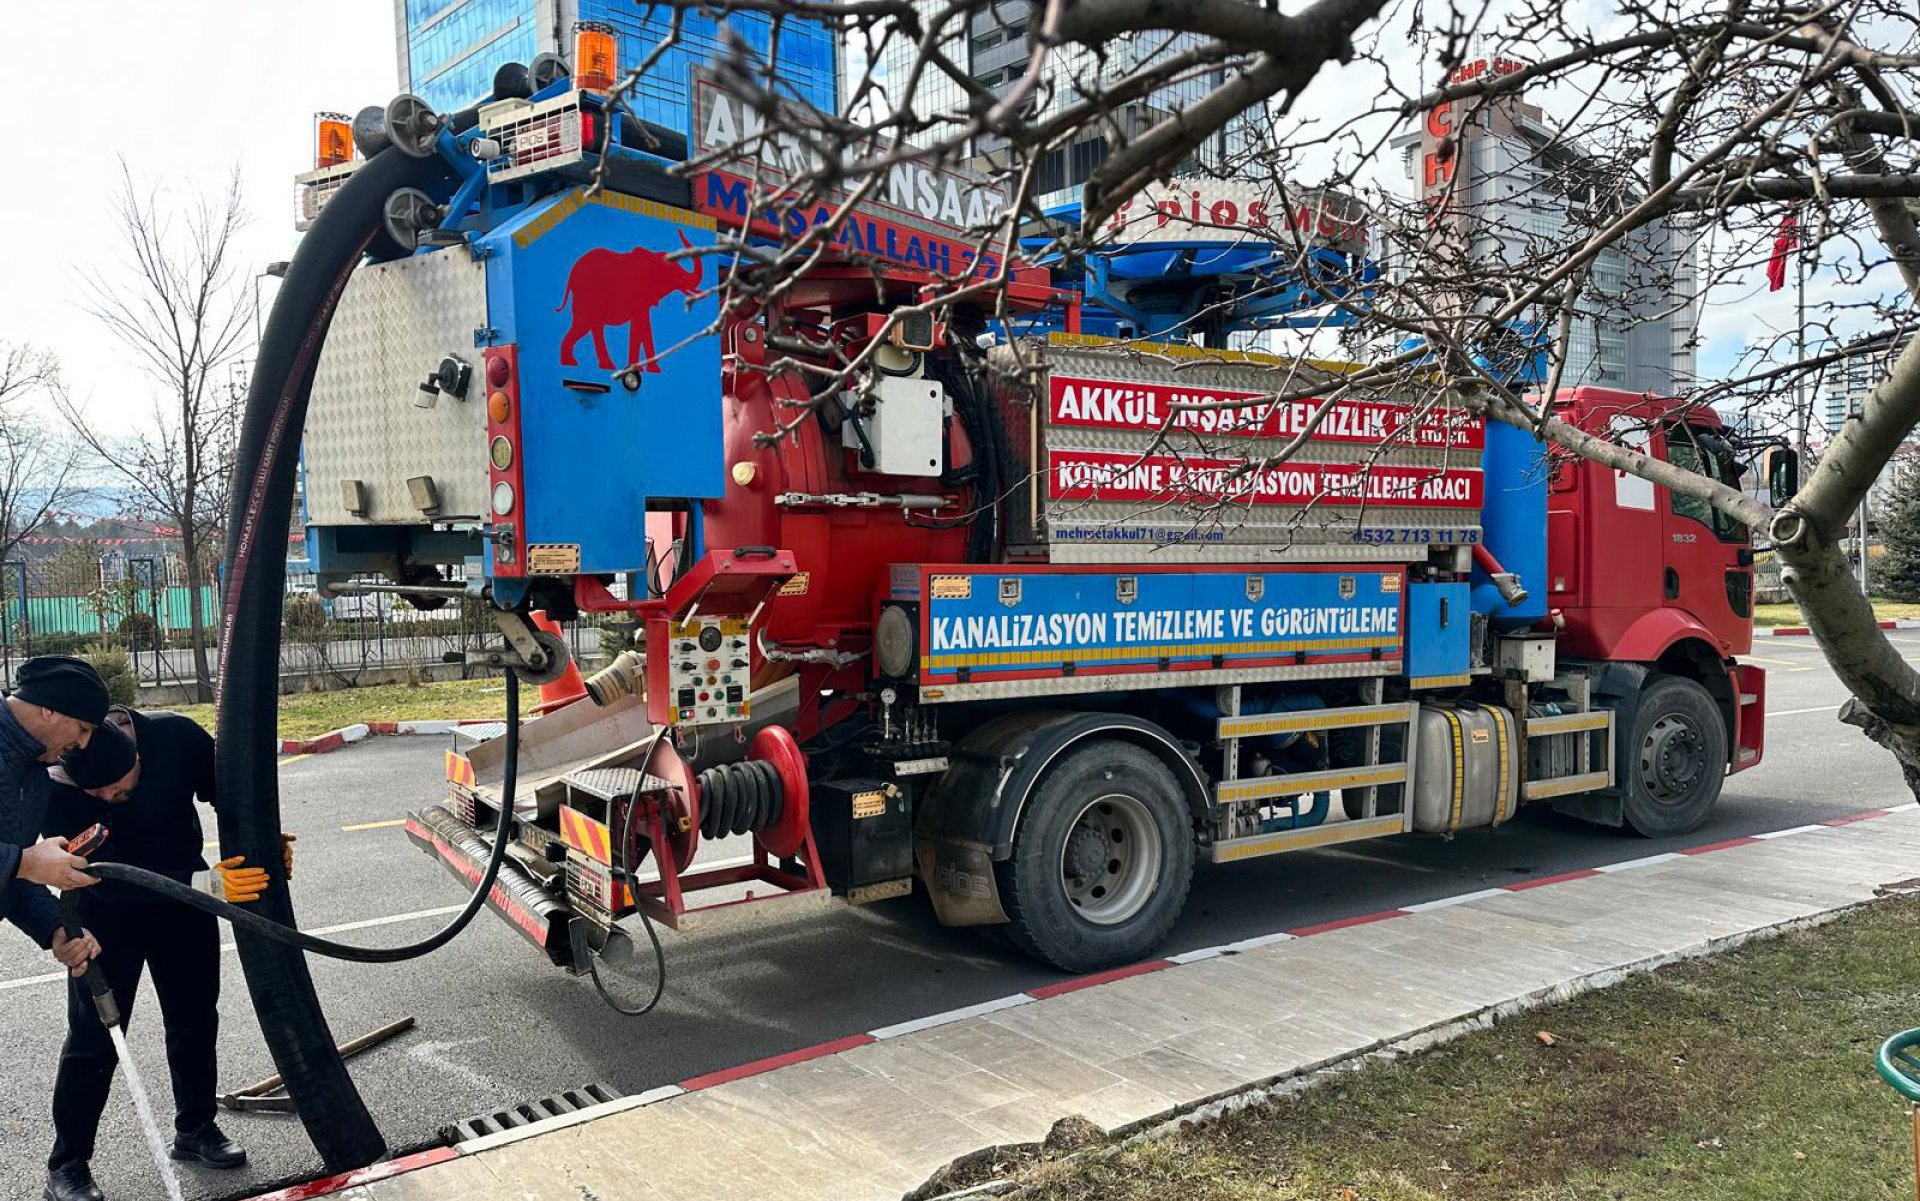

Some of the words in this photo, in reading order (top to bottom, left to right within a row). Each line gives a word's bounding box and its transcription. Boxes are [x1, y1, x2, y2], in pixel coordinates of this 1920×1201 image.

[1057, 385, 1161, 425] AKKÜL
[1276, 402, 1387, 437] TEMİZLİK
[1422, 477, 1470, 500] ARACI
[1353, 528, 1395, 543] 532
[1400, 529, 1430, 543] 713
[1436, 530, 1453, 543] 11
[1459, 530, 1477, 543] 78
[1230, 608, 1254, 637] VE
[1260, 606, 1398, 636] GÖRÜNTÜLEME
